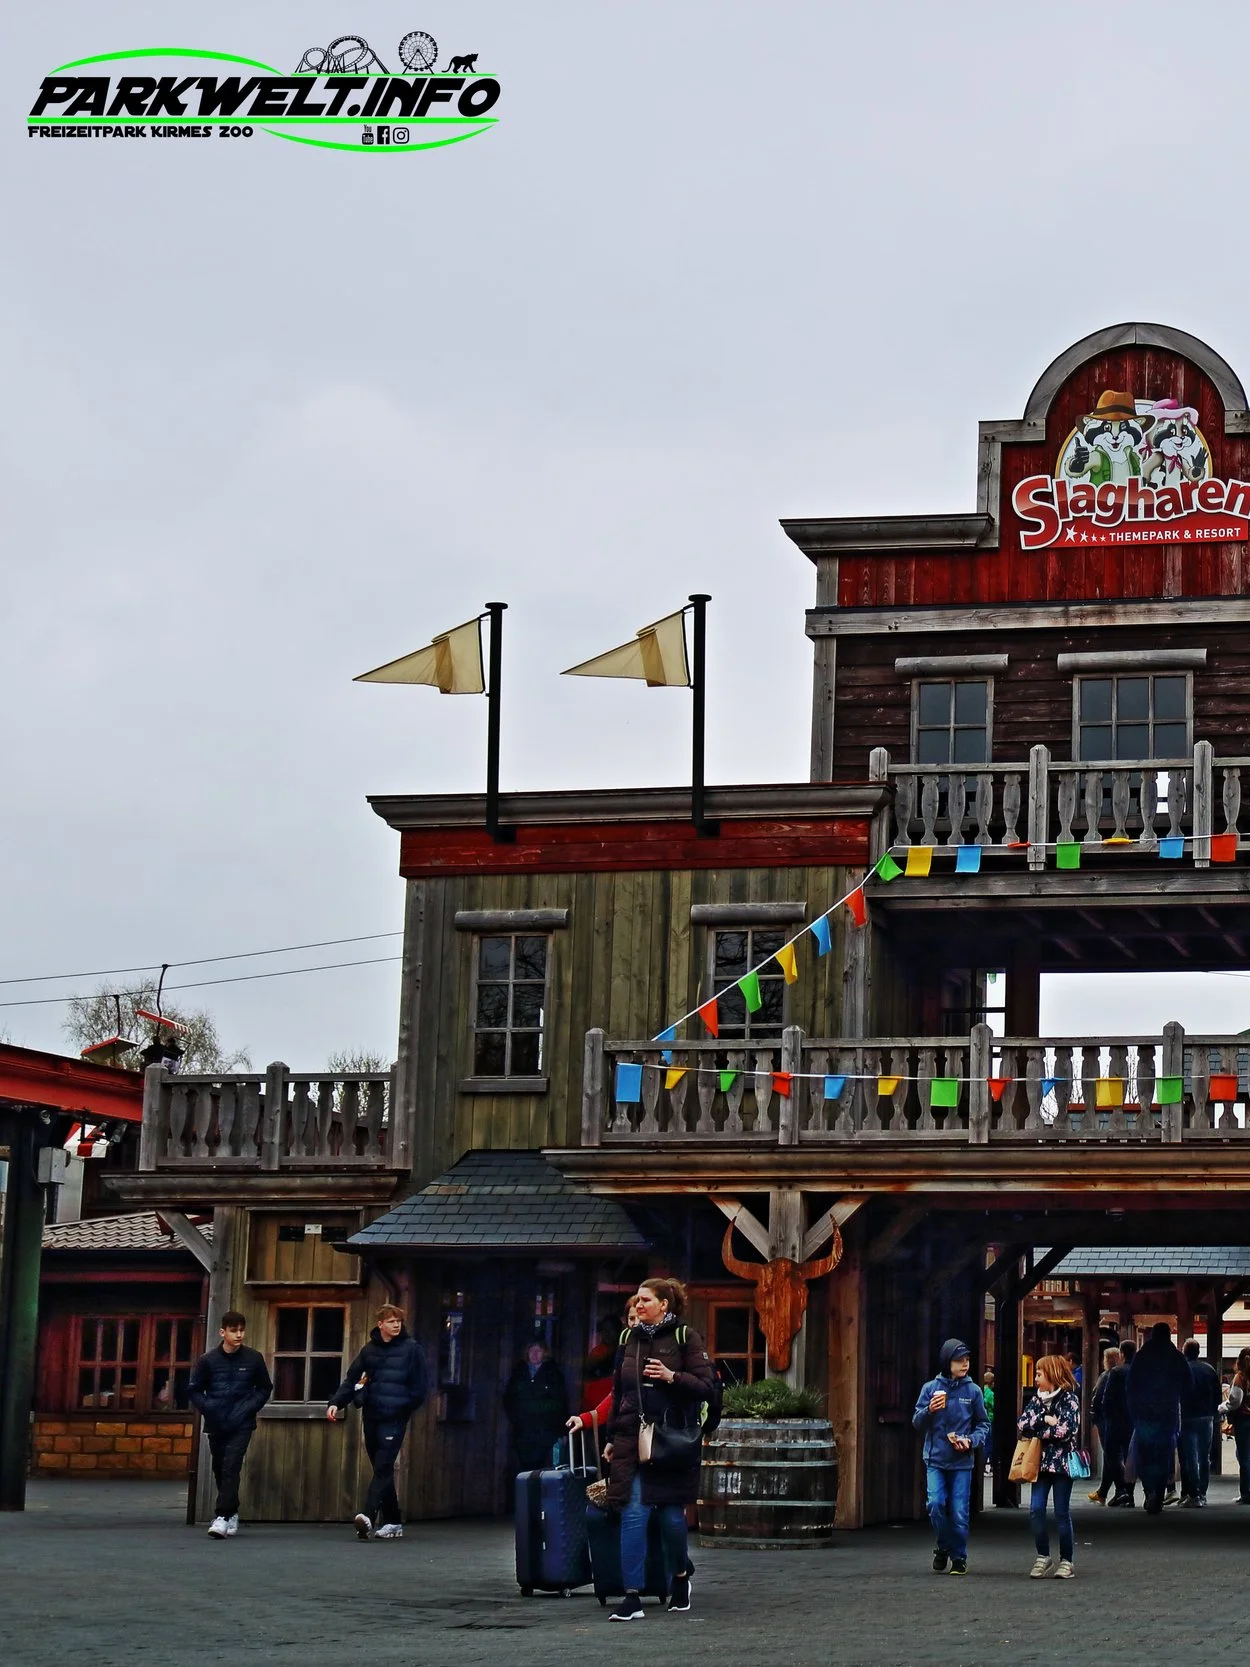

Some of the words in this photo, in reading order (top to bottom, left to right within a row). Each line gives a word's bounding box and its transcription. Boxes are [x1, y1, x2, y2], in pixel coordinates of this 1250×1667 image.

[1109, 529, 1180, 542] THEMEPARK
[1184, 529, 1192, 539] &
[1195, 527, 1241, 539] RESORT
